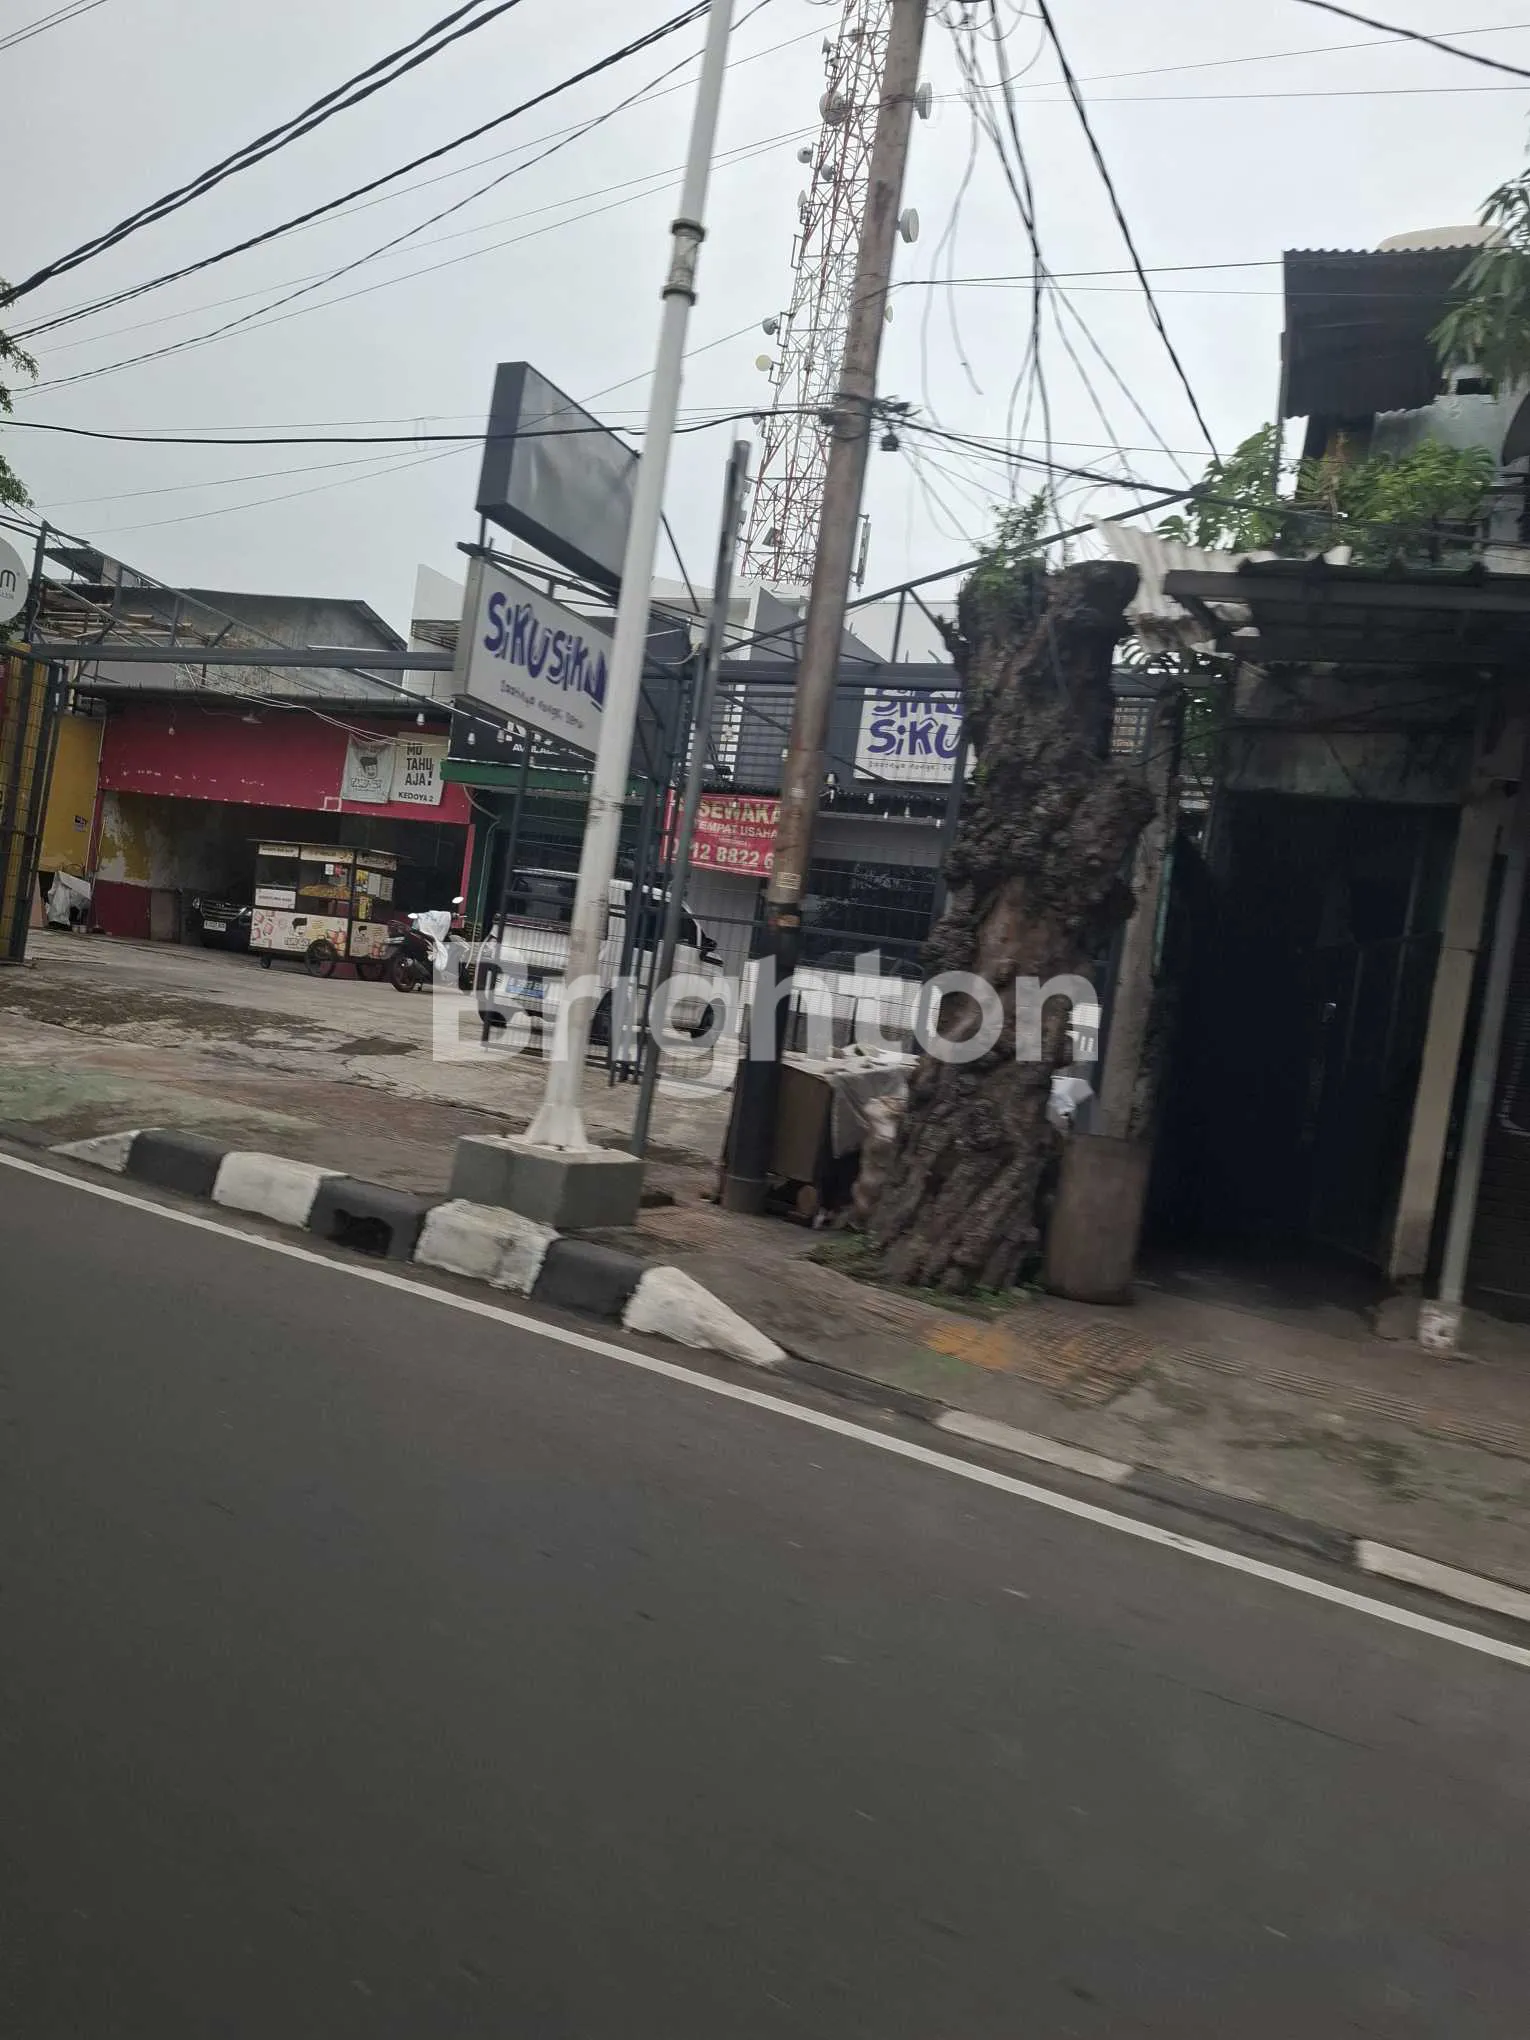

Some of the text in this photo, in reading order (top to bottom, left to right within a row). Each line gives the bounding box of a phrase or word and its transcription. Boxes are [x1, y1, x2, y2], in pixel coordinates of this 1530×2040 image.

[406, 757, 432, 771] TAHU
[398, 791, 427, 802] KEDOYA
[717, 846, 762, 870] 8822
